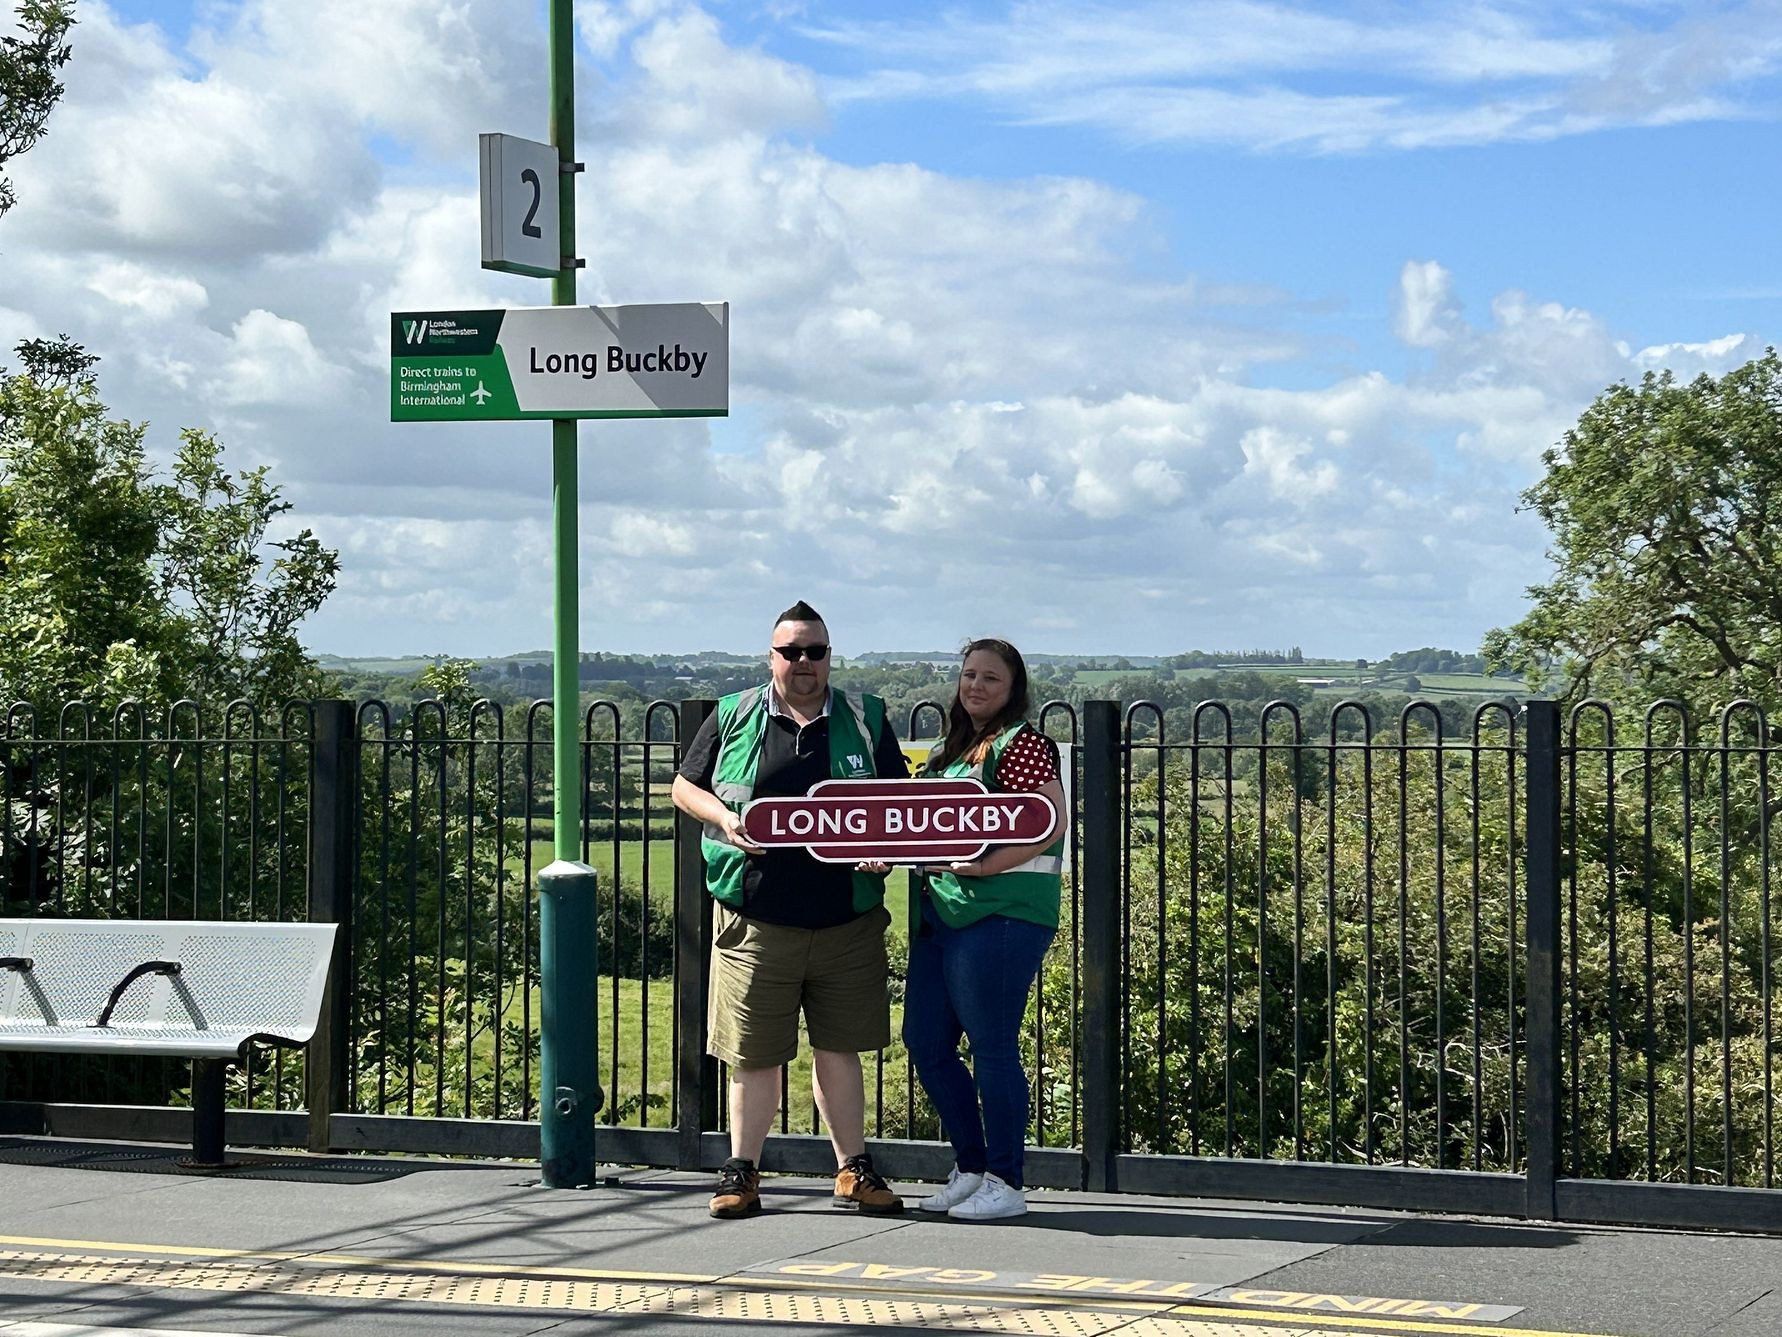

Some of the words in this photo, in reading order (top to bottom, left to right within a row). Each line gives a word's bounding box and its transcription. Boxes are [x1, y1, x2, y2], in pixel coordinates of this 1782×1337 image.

[521, 168, 542, 239] 2
[400, 366, 432, 378] Direct
[434, 366, 463, 377] trains
[465, 366, 477, 377] to
[530, 346, 597, 380] Long
[607, 344, 708, 379] Buckby
[400, 380, 462, 394] Birmingham
[400, 394, 466, 406] International
[771, 808, 868, 836] LONG
[885, 804, 1025, 834] BUCKBY
[778, 1262, 998, 1284] GAP
[1015, 1273, 1197, 1299] THE
[1229, 1289, 1483, 1319] MIND
